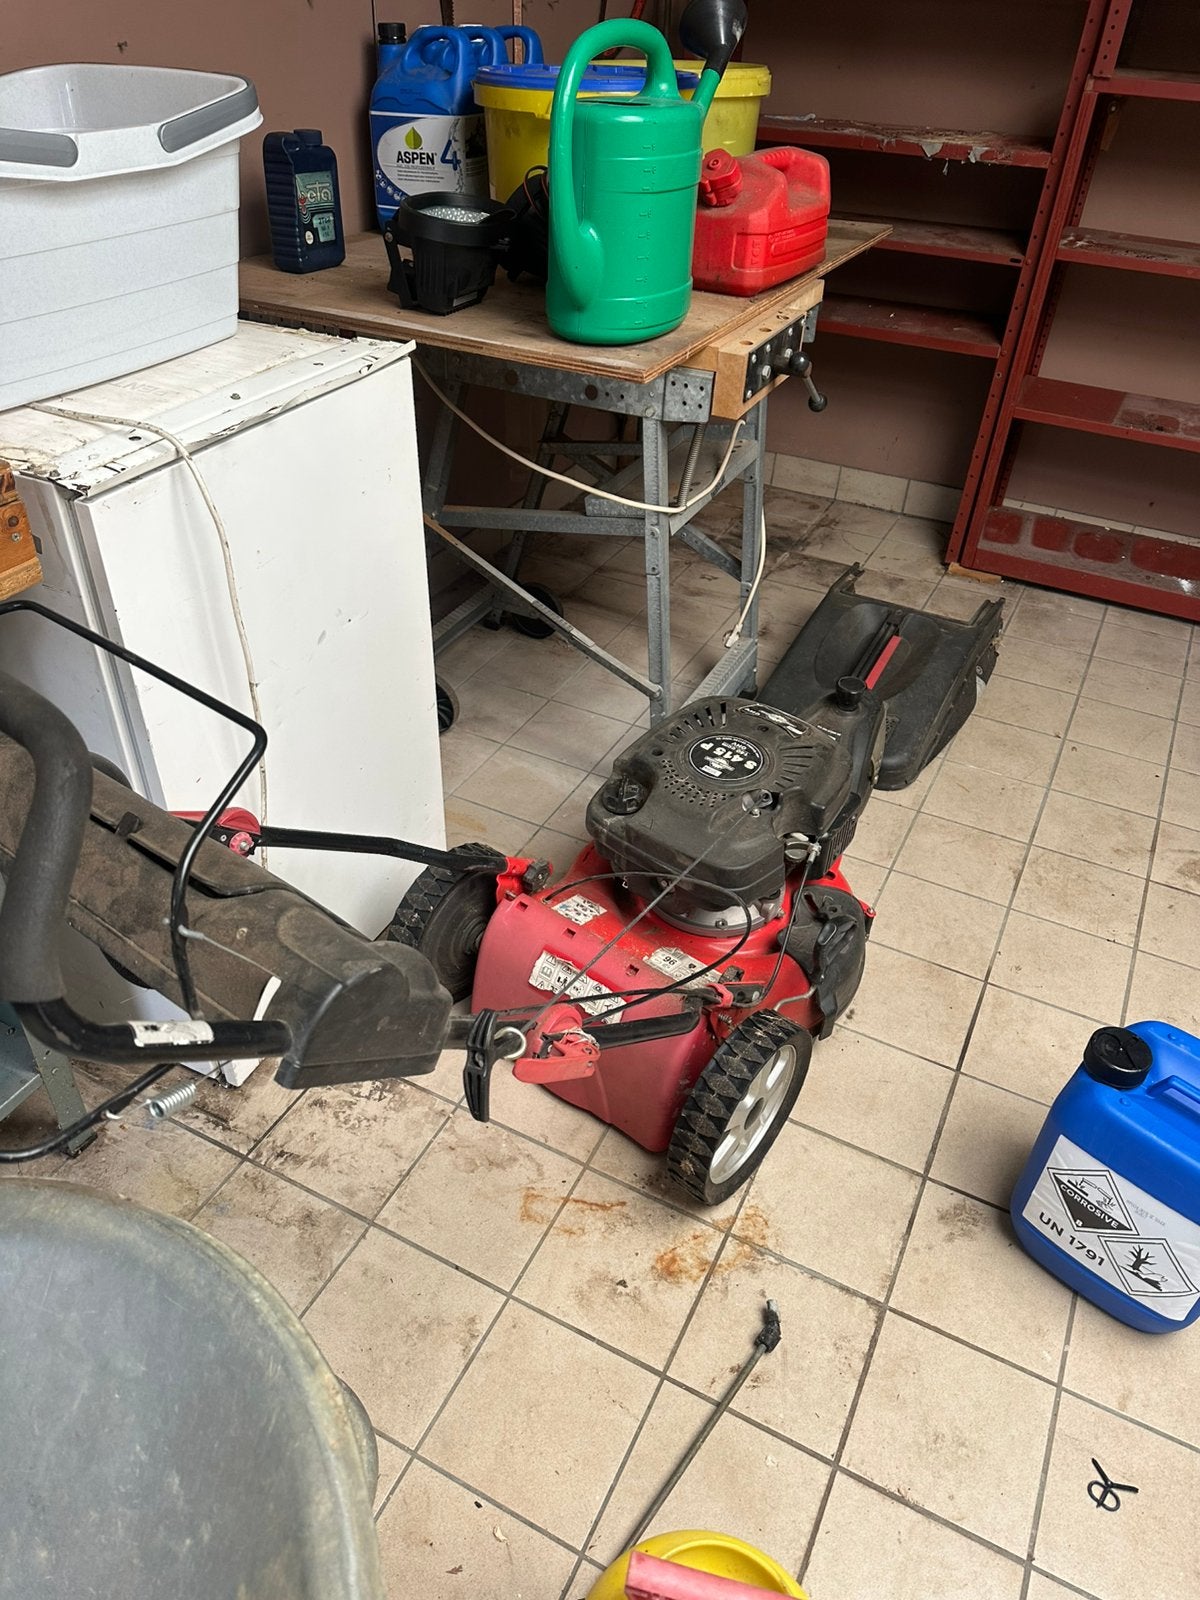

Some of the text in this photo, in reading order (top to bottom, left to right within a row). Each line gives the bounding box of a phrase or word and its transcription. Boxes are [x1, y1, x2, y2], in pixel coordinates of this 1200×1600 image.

[396, 150, 435, 165] ASPEN
[440, 139, 461, 171] 4
[700, 742, 715, 751] P
[713, 747, 744, 762] 415
[744, 760, 757, 770] S
[663, 955, 678, 965] 96
[1060, 1184, 1119, 1229] CORROSIVE
[1039, 1212, 1105, 1266] UN 1791
